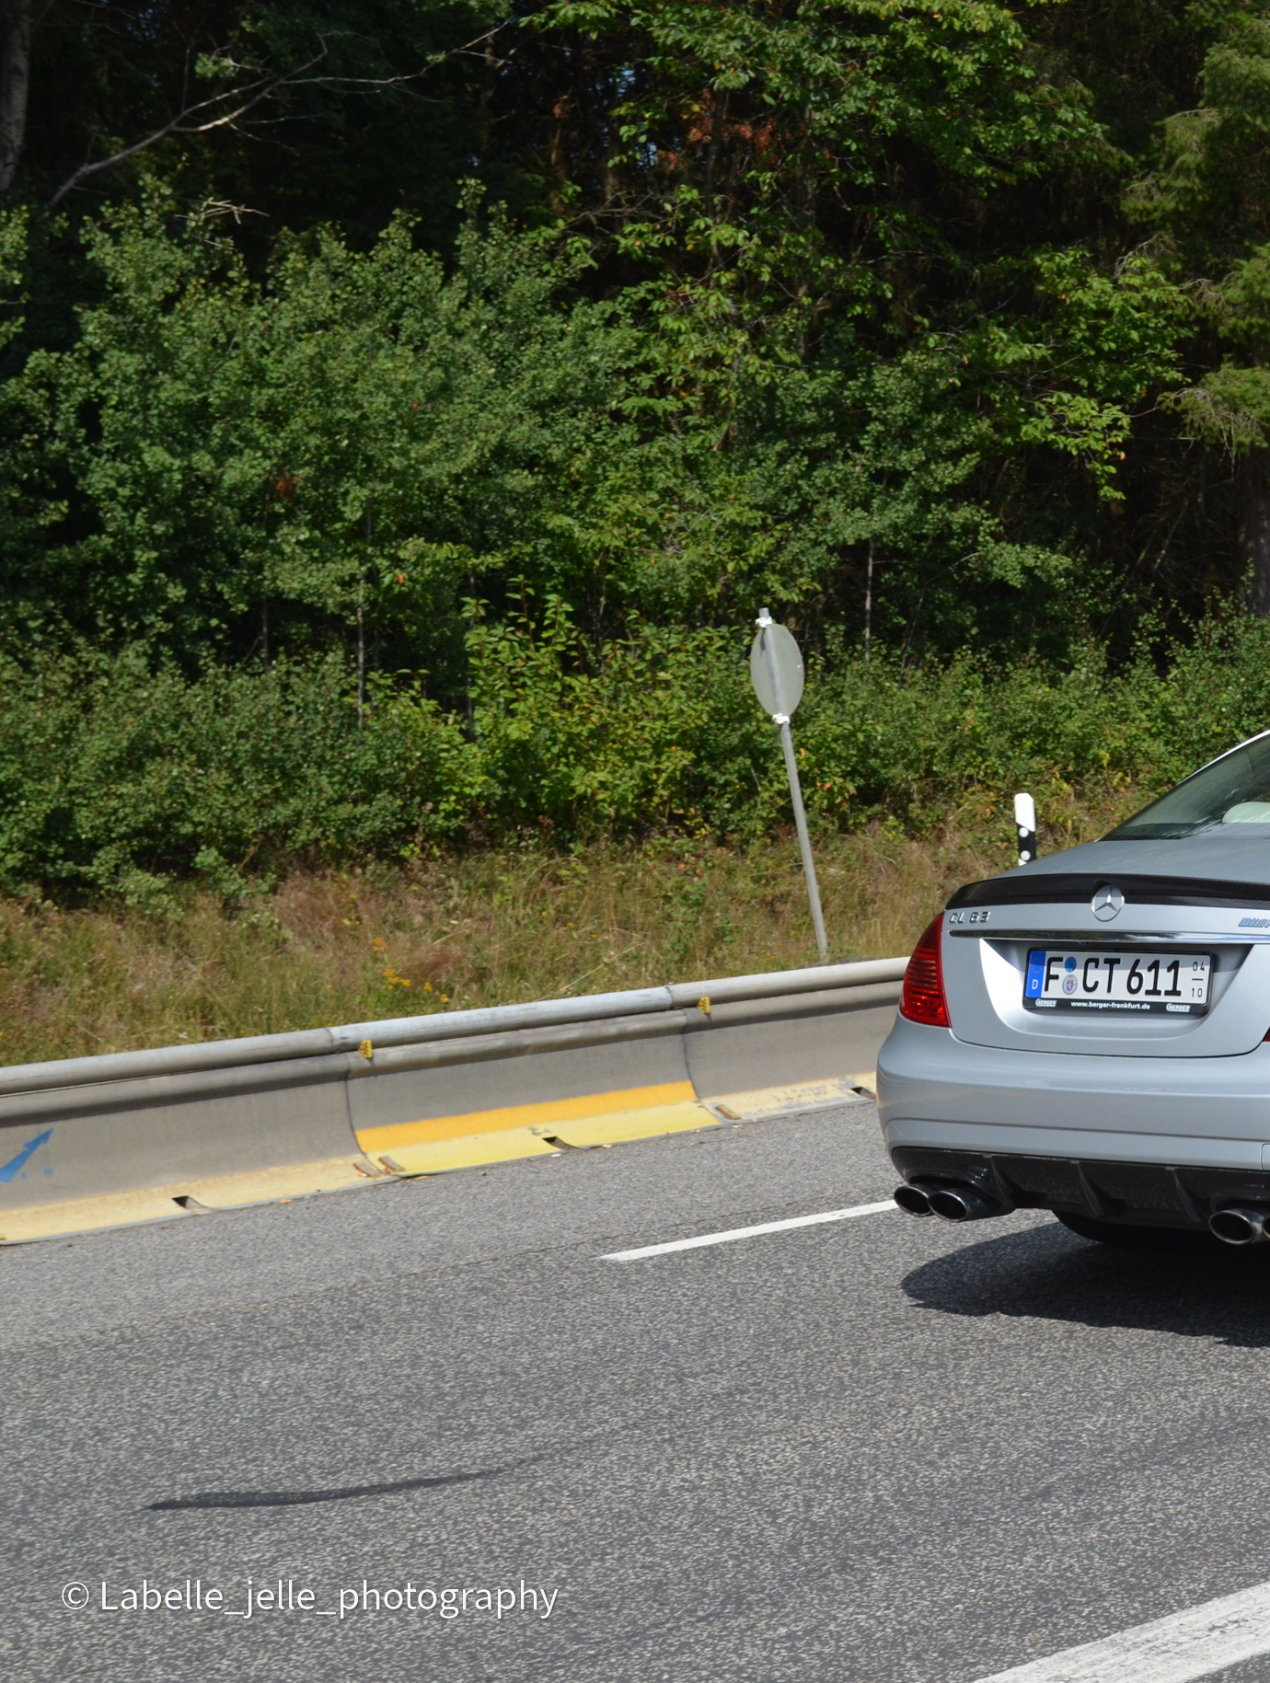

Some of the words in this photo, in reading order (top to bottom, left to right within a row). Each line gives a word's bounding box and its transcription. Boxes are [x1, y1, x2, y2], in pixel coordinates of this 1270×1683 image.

[949, 912, 965, 924] CL
[970, 911, 991, 924] 63
[1192, 960, 1205, 971] 04
[1044, 956, 1063, 992] F
[1082, 957, 1121, 994] CT
[1126, 958, 1182, 996] 611
[1031, 979, 1038, 990] D
[1191, 987, 1203, 998] 10
[1070, 1000, 1151, 1011] www.berger-frankfurt.de
